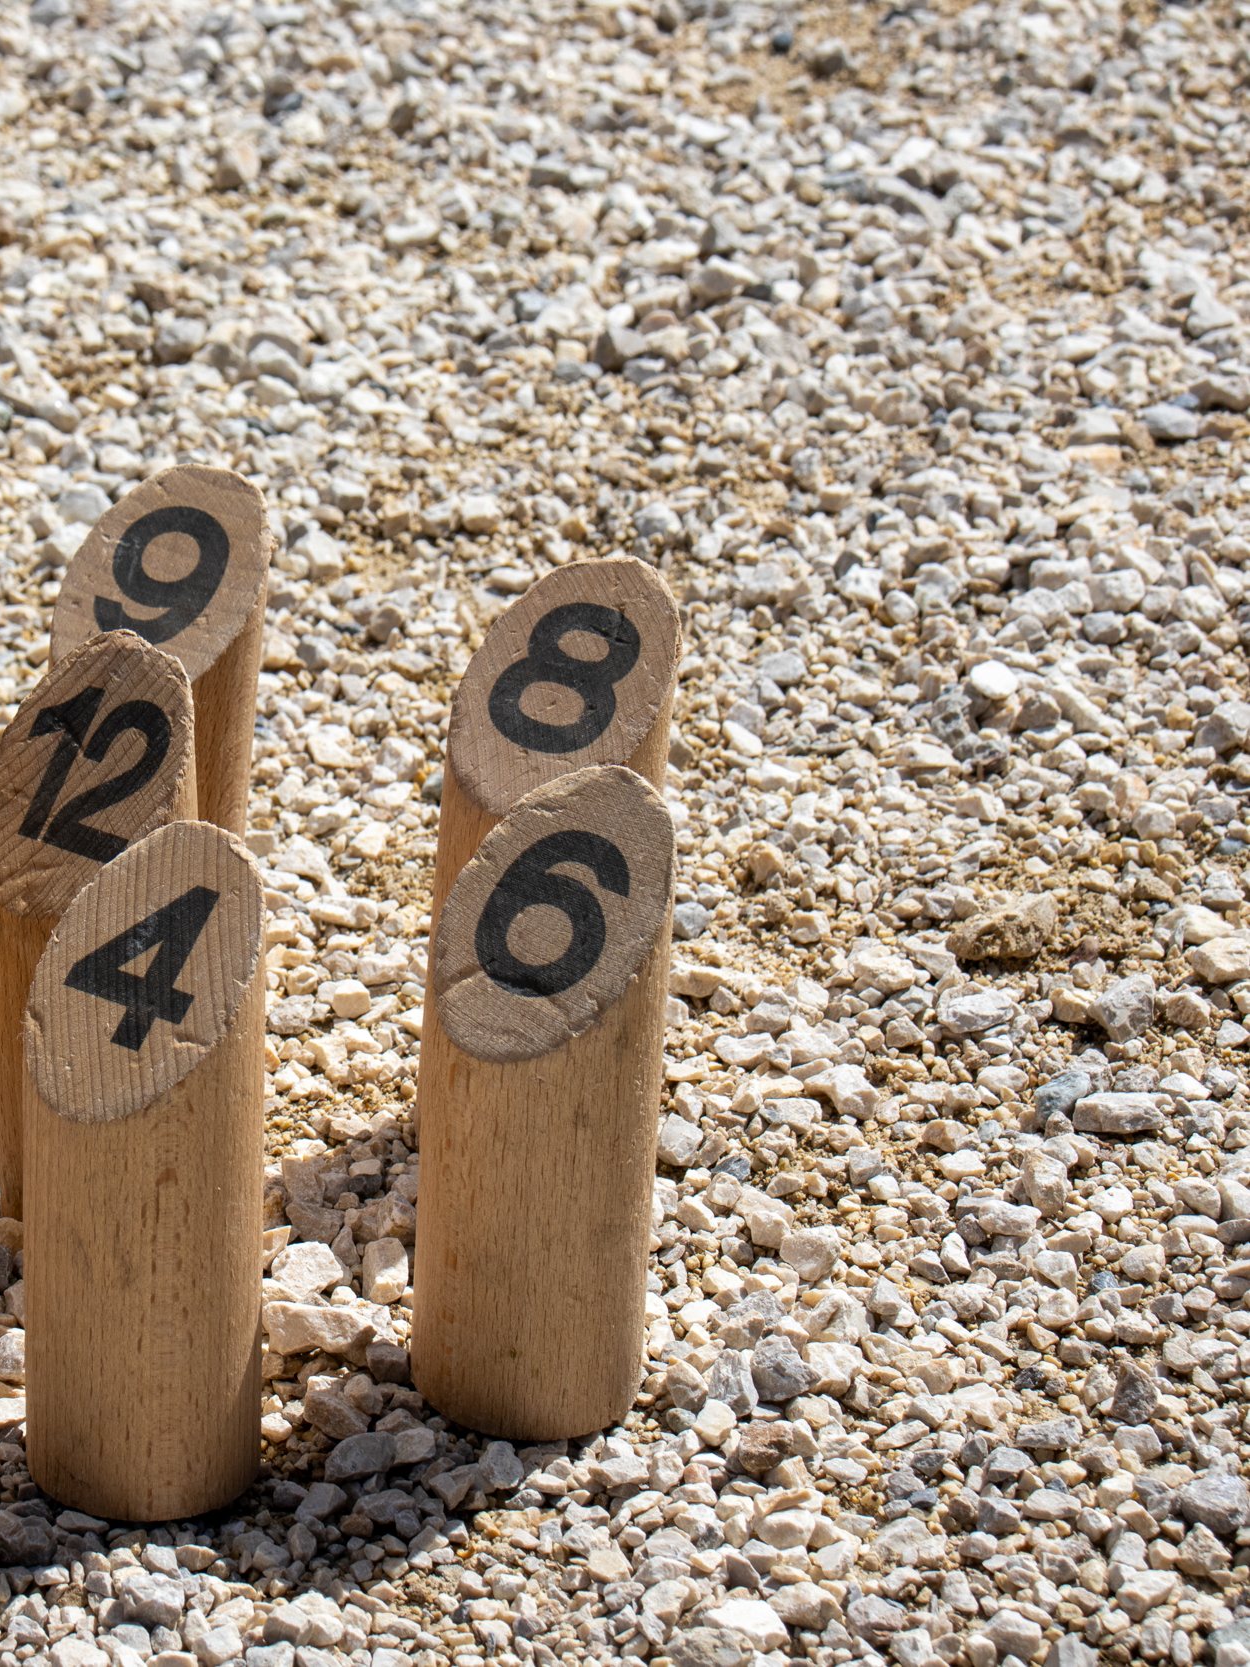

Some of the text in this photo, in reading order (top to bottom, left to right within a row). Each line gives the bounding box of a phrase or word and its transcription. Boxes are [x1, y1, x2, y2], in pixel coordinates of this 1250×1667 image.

[94, 506, 230, 644] 9
[488, 602, 641, 754] 8
[18, 686, 171, 864] 12
[63, 886, 220, 1052] 4
[474, 829, 631, 999] 6
